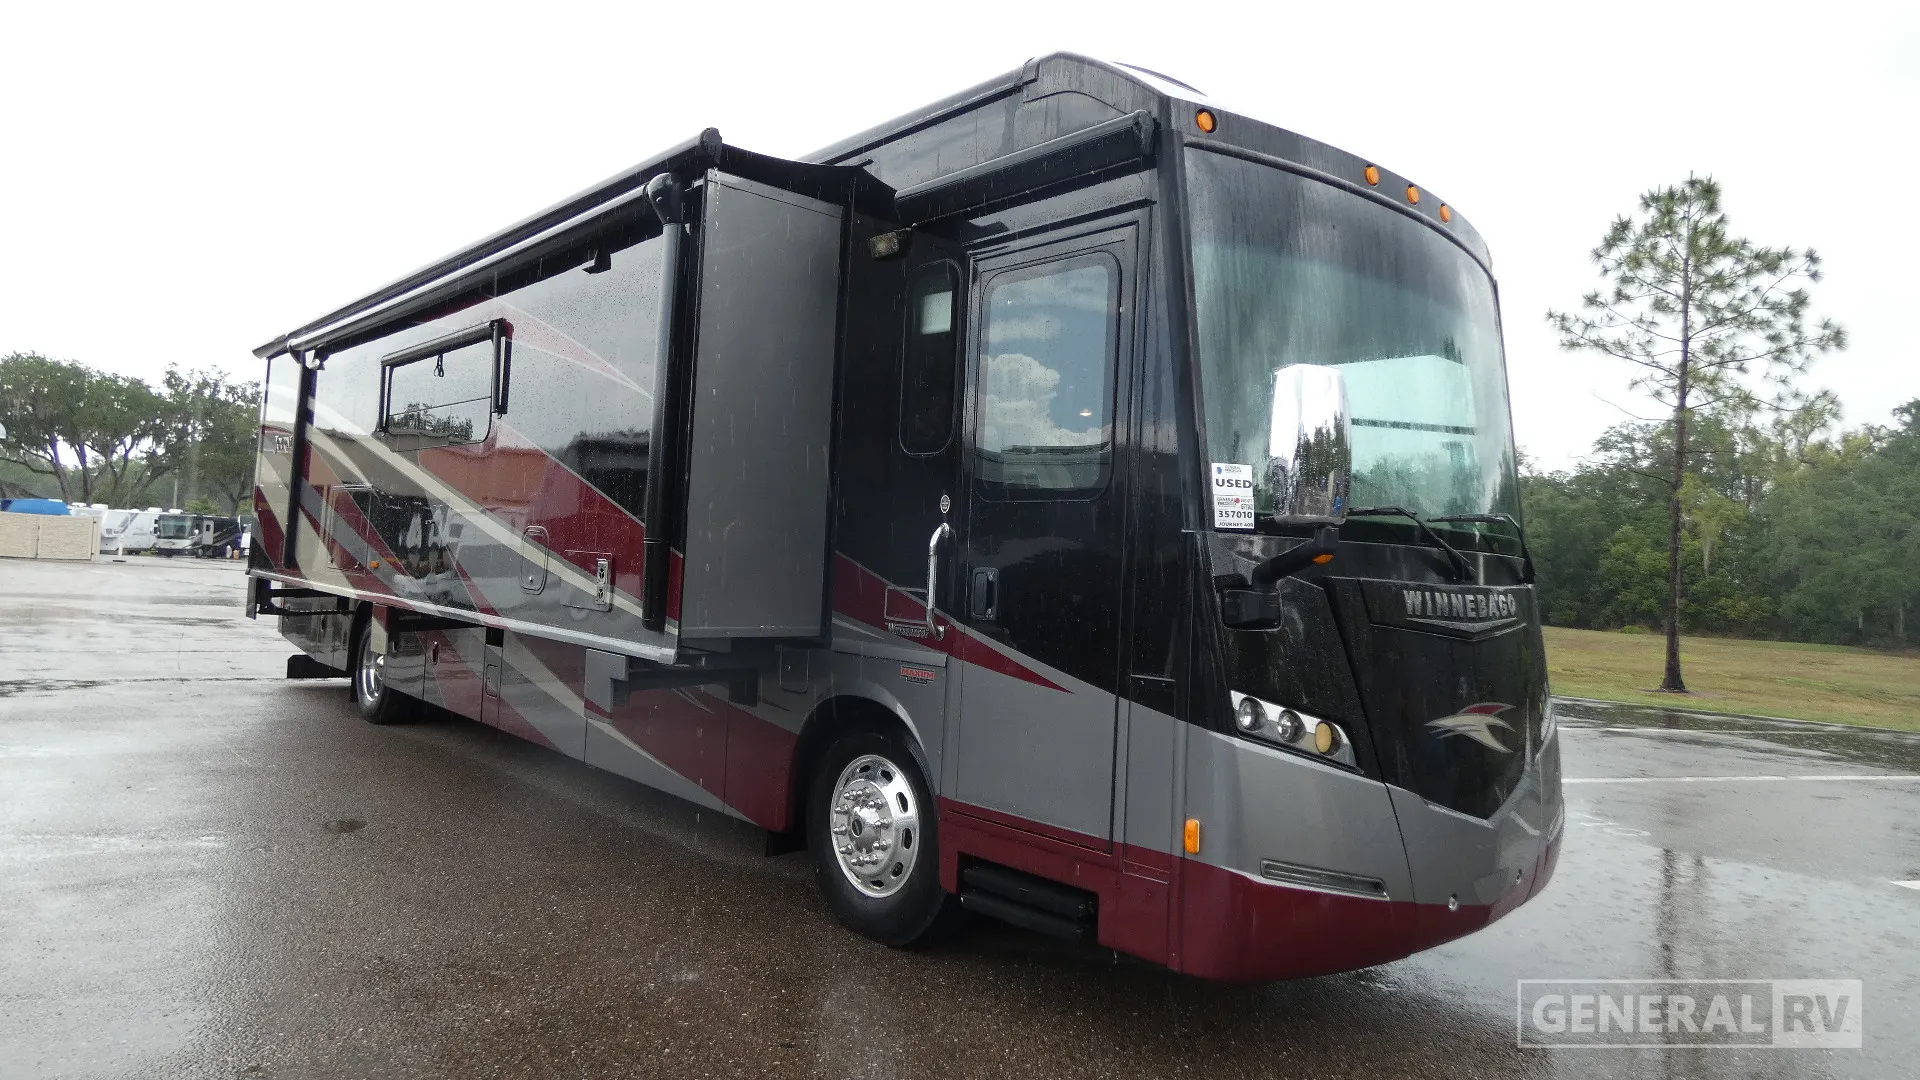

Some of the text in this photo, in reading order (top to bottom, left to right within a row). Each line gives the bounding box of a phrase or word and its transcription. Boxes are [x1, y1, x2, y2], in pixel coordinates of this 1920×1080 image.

[1216, 478, 1252, 488] USED
[1218, 510, 1252, 518] 357010
[1403, 590, 1516, 618] WINNEBAGO
